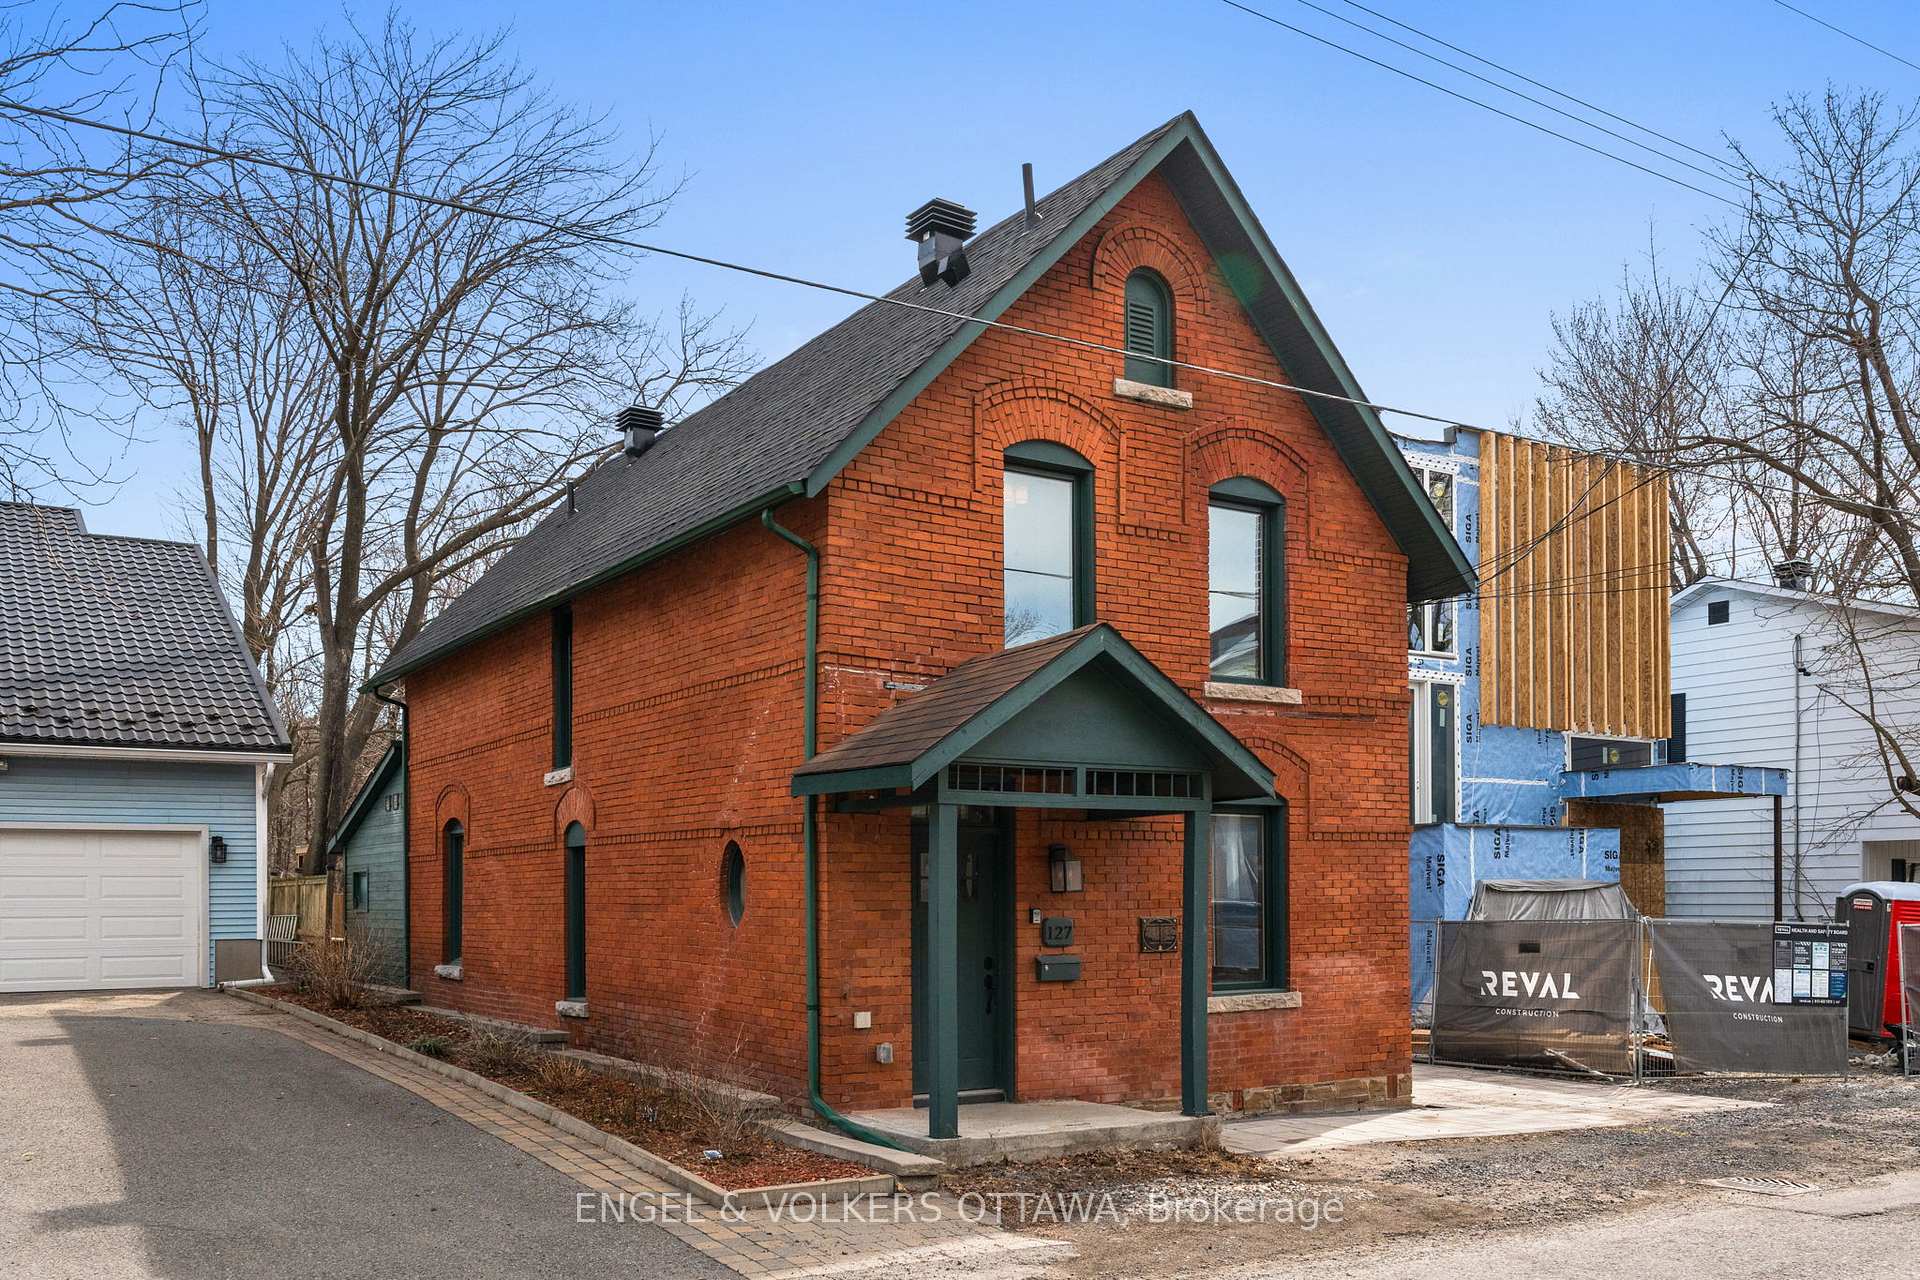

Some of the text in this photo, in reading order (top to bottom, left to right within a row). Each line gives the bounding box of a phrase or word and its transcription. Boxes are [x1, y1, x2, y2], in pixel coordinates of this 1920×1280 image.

[1436, 854, 1445, 887] SIGA
[1048, 926, 1072, 940] 127
[1480, 970, 1580, 999] REVAL
[1495, 1008, 1560, 1018] CONSTRUCTION
[1733, 1012, 1783, 1023] CONSTRUCTION
